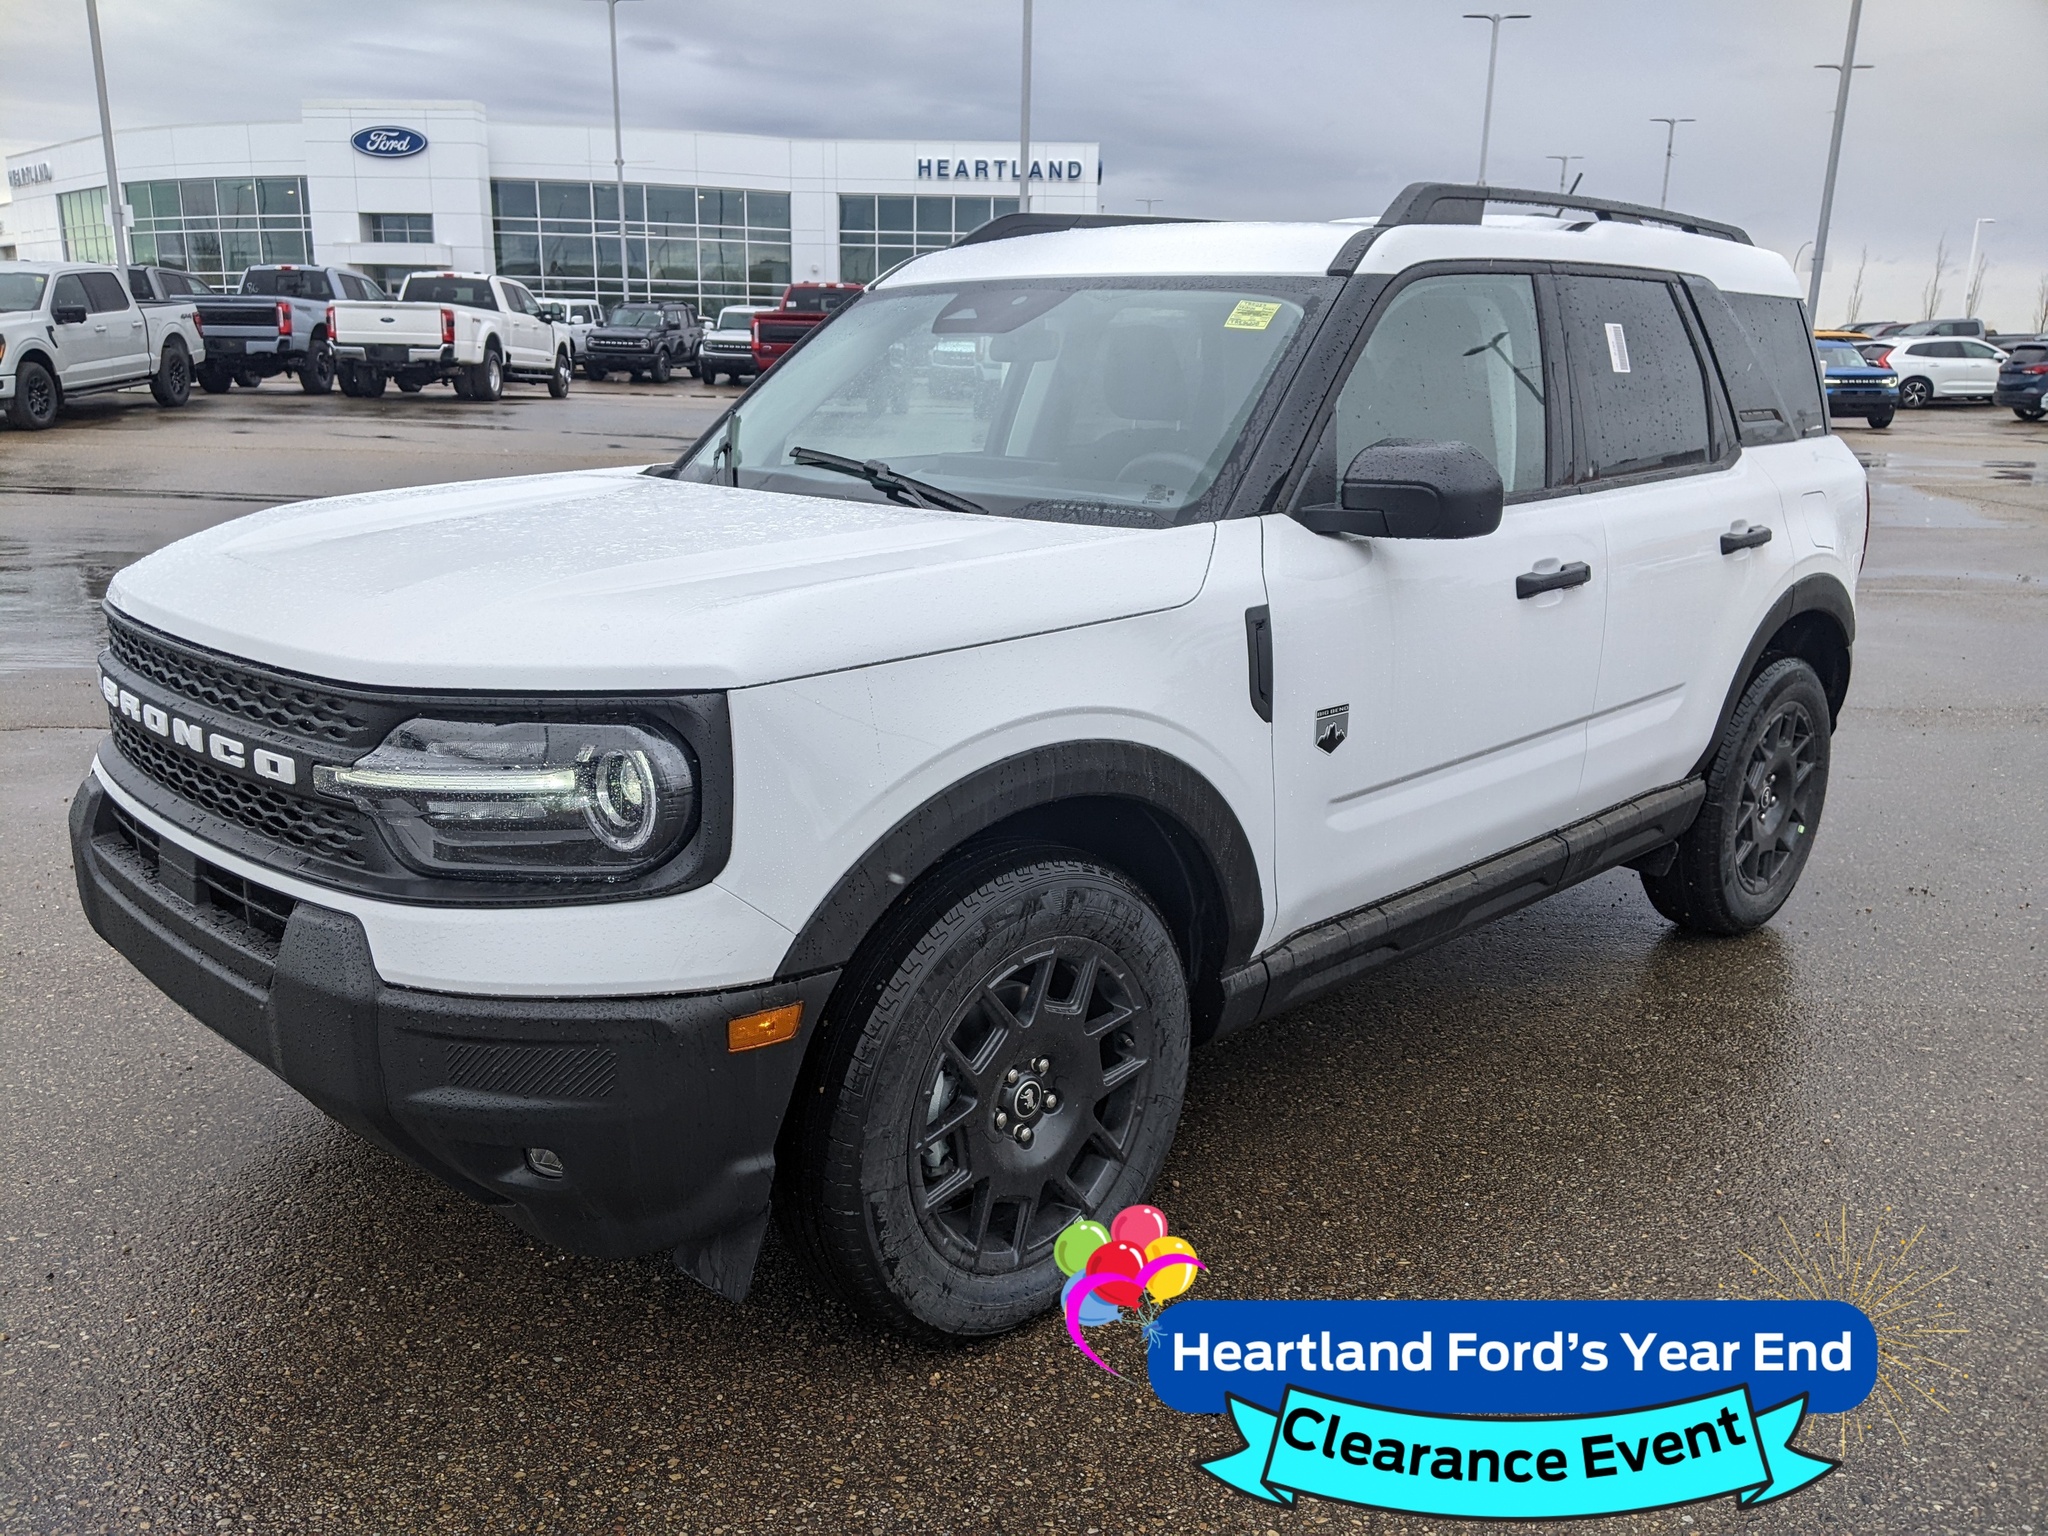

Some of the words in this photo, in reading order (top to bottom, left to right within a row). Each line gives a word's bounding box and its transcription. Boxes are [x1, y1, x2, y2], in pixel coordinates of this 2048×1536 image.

[366, 130, 410, 151] Ford
[917, 158, 1082, 180] HEARTLAND
[102, 676, 296, 785] BRONCO
